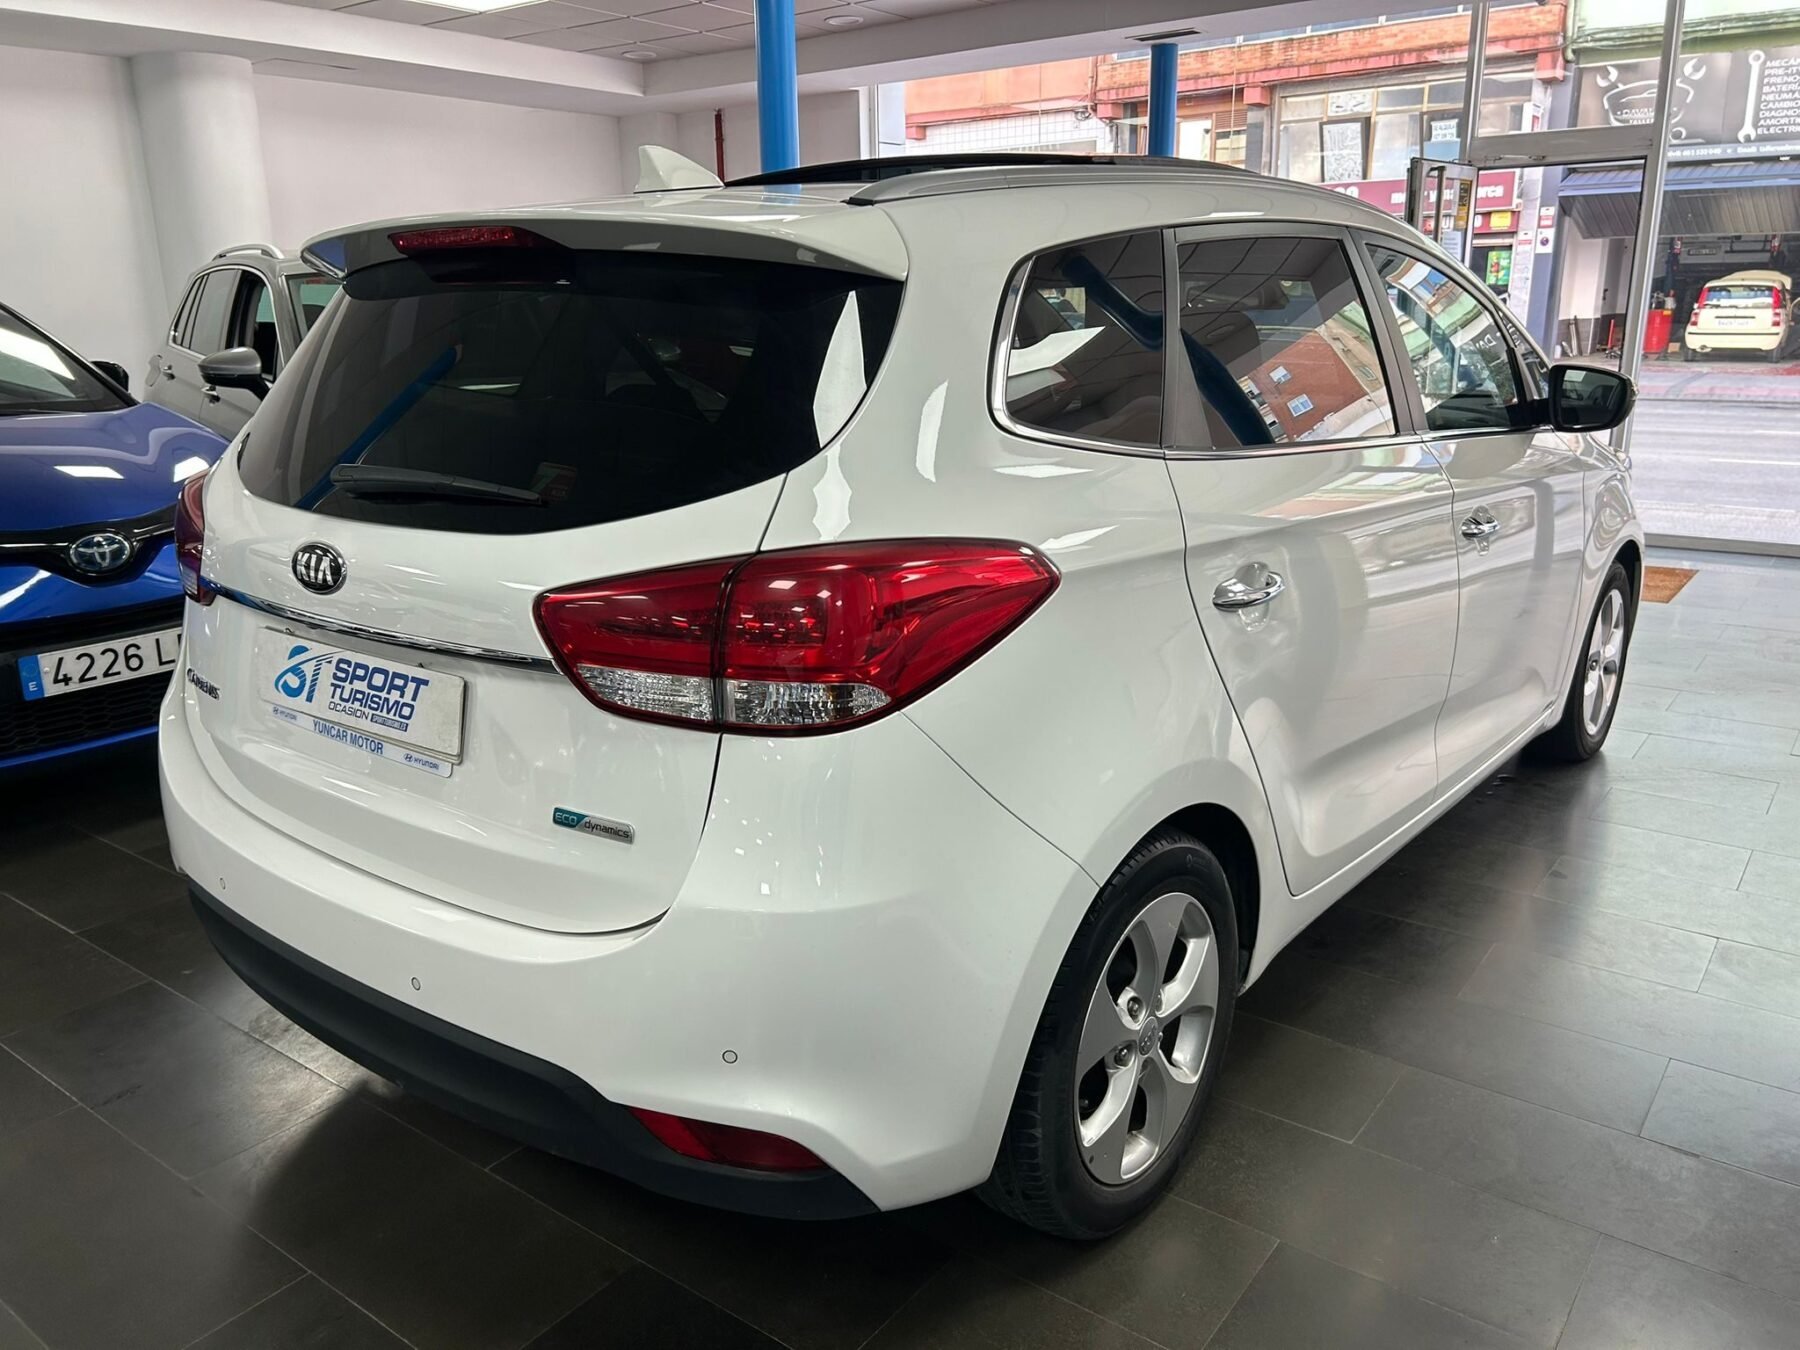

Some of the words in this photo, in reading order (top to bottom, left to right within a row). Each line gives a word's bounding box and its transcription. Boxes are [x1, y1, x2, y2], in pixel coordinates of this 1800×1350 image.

[1763, 75, 1800, 85] FRENO
[1764, 66, 1800, 77] PRE-IT
[1759, 108, 1800, 118] DIAGNO
[295, 551, 334, 586] KIA
[28, 681, 39, 691] E
[52, 643, 144, 687] 4226
[155, 633, 183, 667] L
[331, 657, 430, 703] SPORT
[327, 701, 370, 720] OCASION
[329, 682, 416, 721] TURISMO
[312, 719, 349, 743] YUNCAR
[349, 732, 385, 756] MOTOR
[413, 756, 440, 772] HYUNDAI
[555, 811, 577, 826] ECO
[584, 819, 630, 839] dynamics
